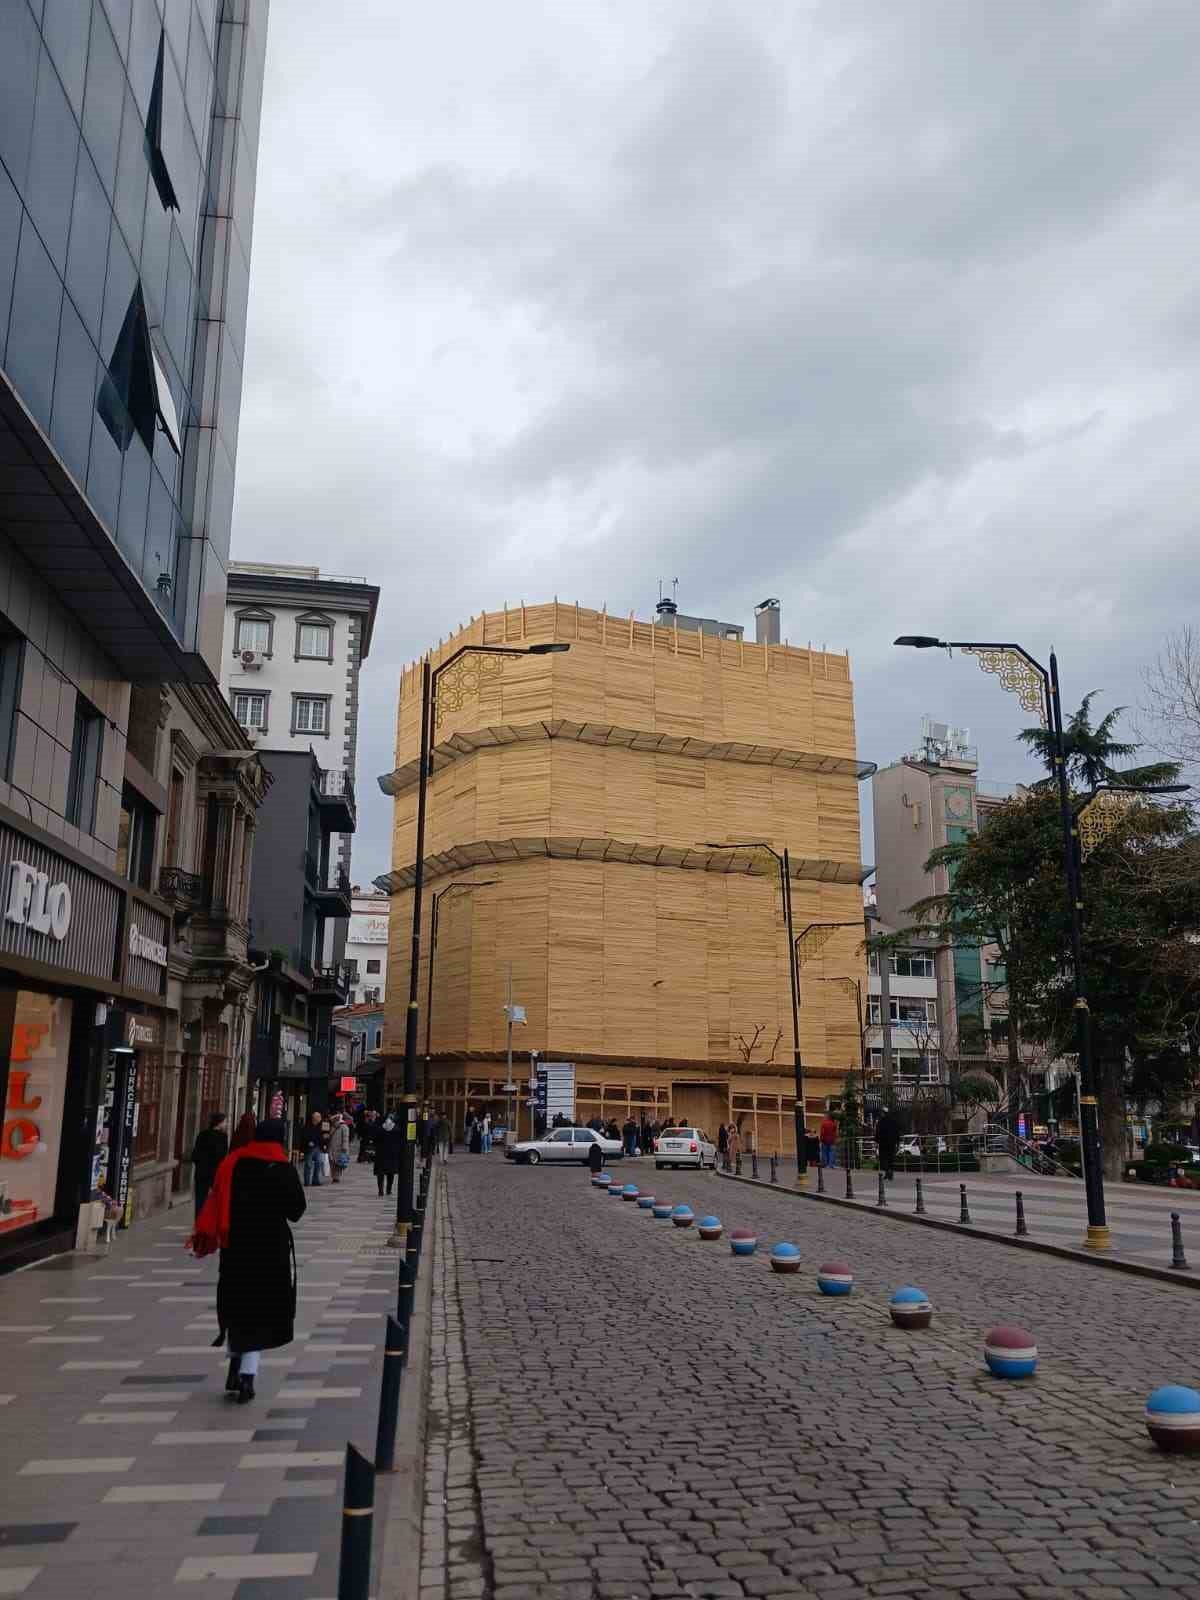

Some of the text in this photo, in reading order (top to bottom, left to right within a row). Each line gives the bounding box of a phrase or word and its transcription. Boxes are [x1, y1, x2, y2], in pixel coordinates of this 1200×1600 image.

[5, 860, 71, 941] FLO
[1, 1024, 49, 1160] FLO
[125, 1058, 136, 1127] TURKCELL
